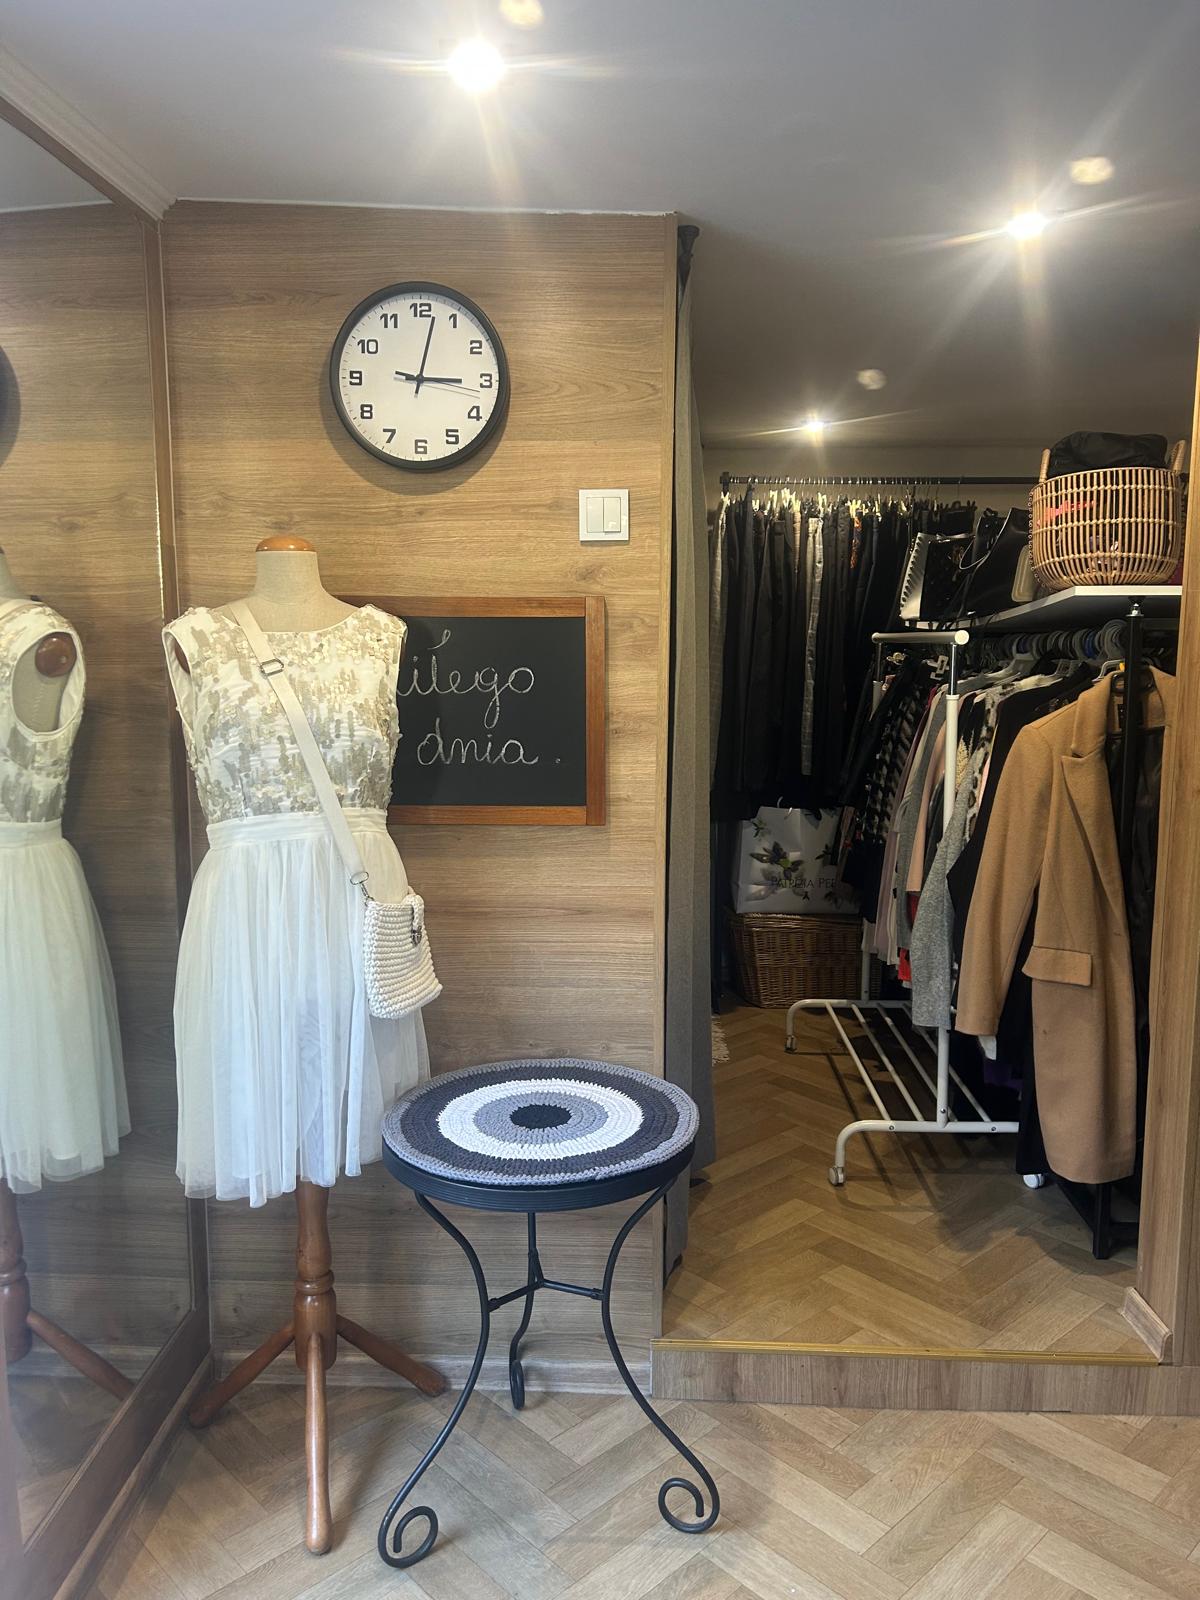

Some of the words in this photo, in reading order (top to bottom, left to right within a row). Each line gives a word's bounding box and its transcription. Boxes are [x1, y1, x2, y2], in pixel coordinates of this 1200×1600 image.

[409, 303, 432, 318] 12
[380, 314, 398, 329] 11
[449, 314, 458, 329] 1
[357, 339, 379, 354] 10
[469, 340, 483, 355] 2
[349, 371, 363, 386] 9
[480, 374, 493, 389] 3
[360, 404, 373, 419] 8
[468, 406, 483, 421] 4
[383, 429, 397, 444] 7
[446, 429, 460, 444] 5
[415, 440, 428, 455] 6
